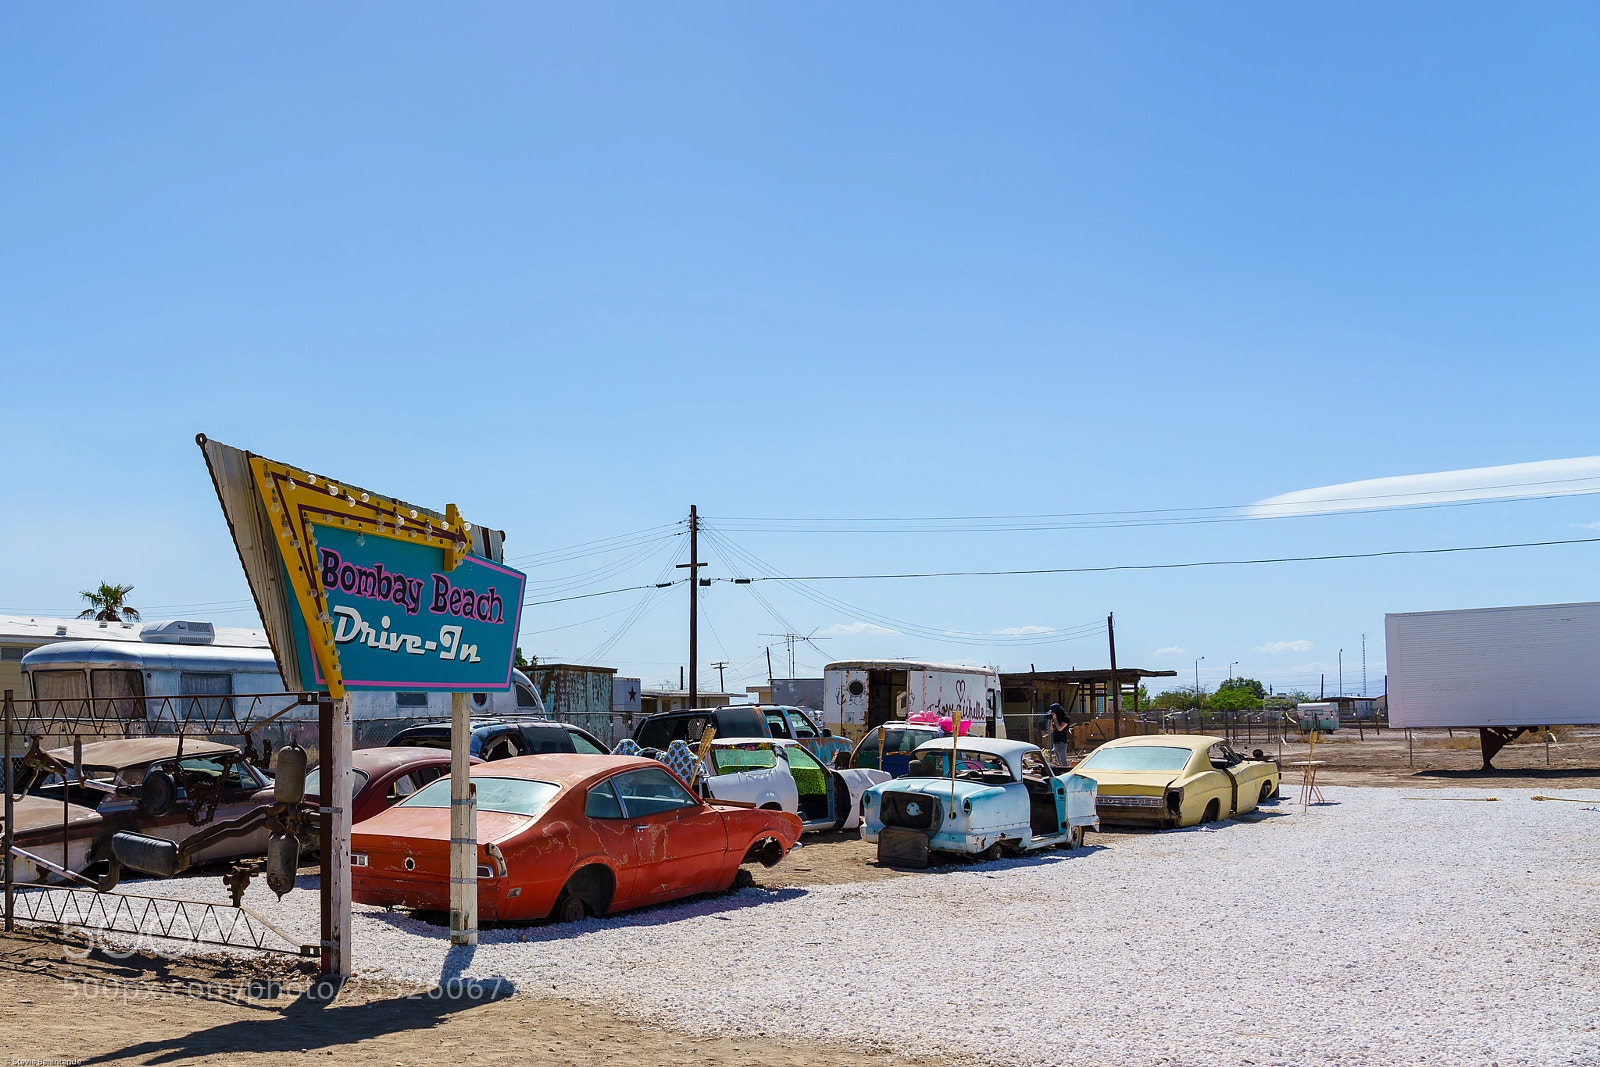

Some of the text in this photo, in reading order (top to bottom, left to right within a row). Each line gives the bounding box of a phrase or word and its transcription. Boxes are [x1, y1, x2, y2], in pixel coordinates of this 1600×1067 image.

[319, 548, 504, 624] Bombay Beach
[333, 605, 480, 662] Drive-In
